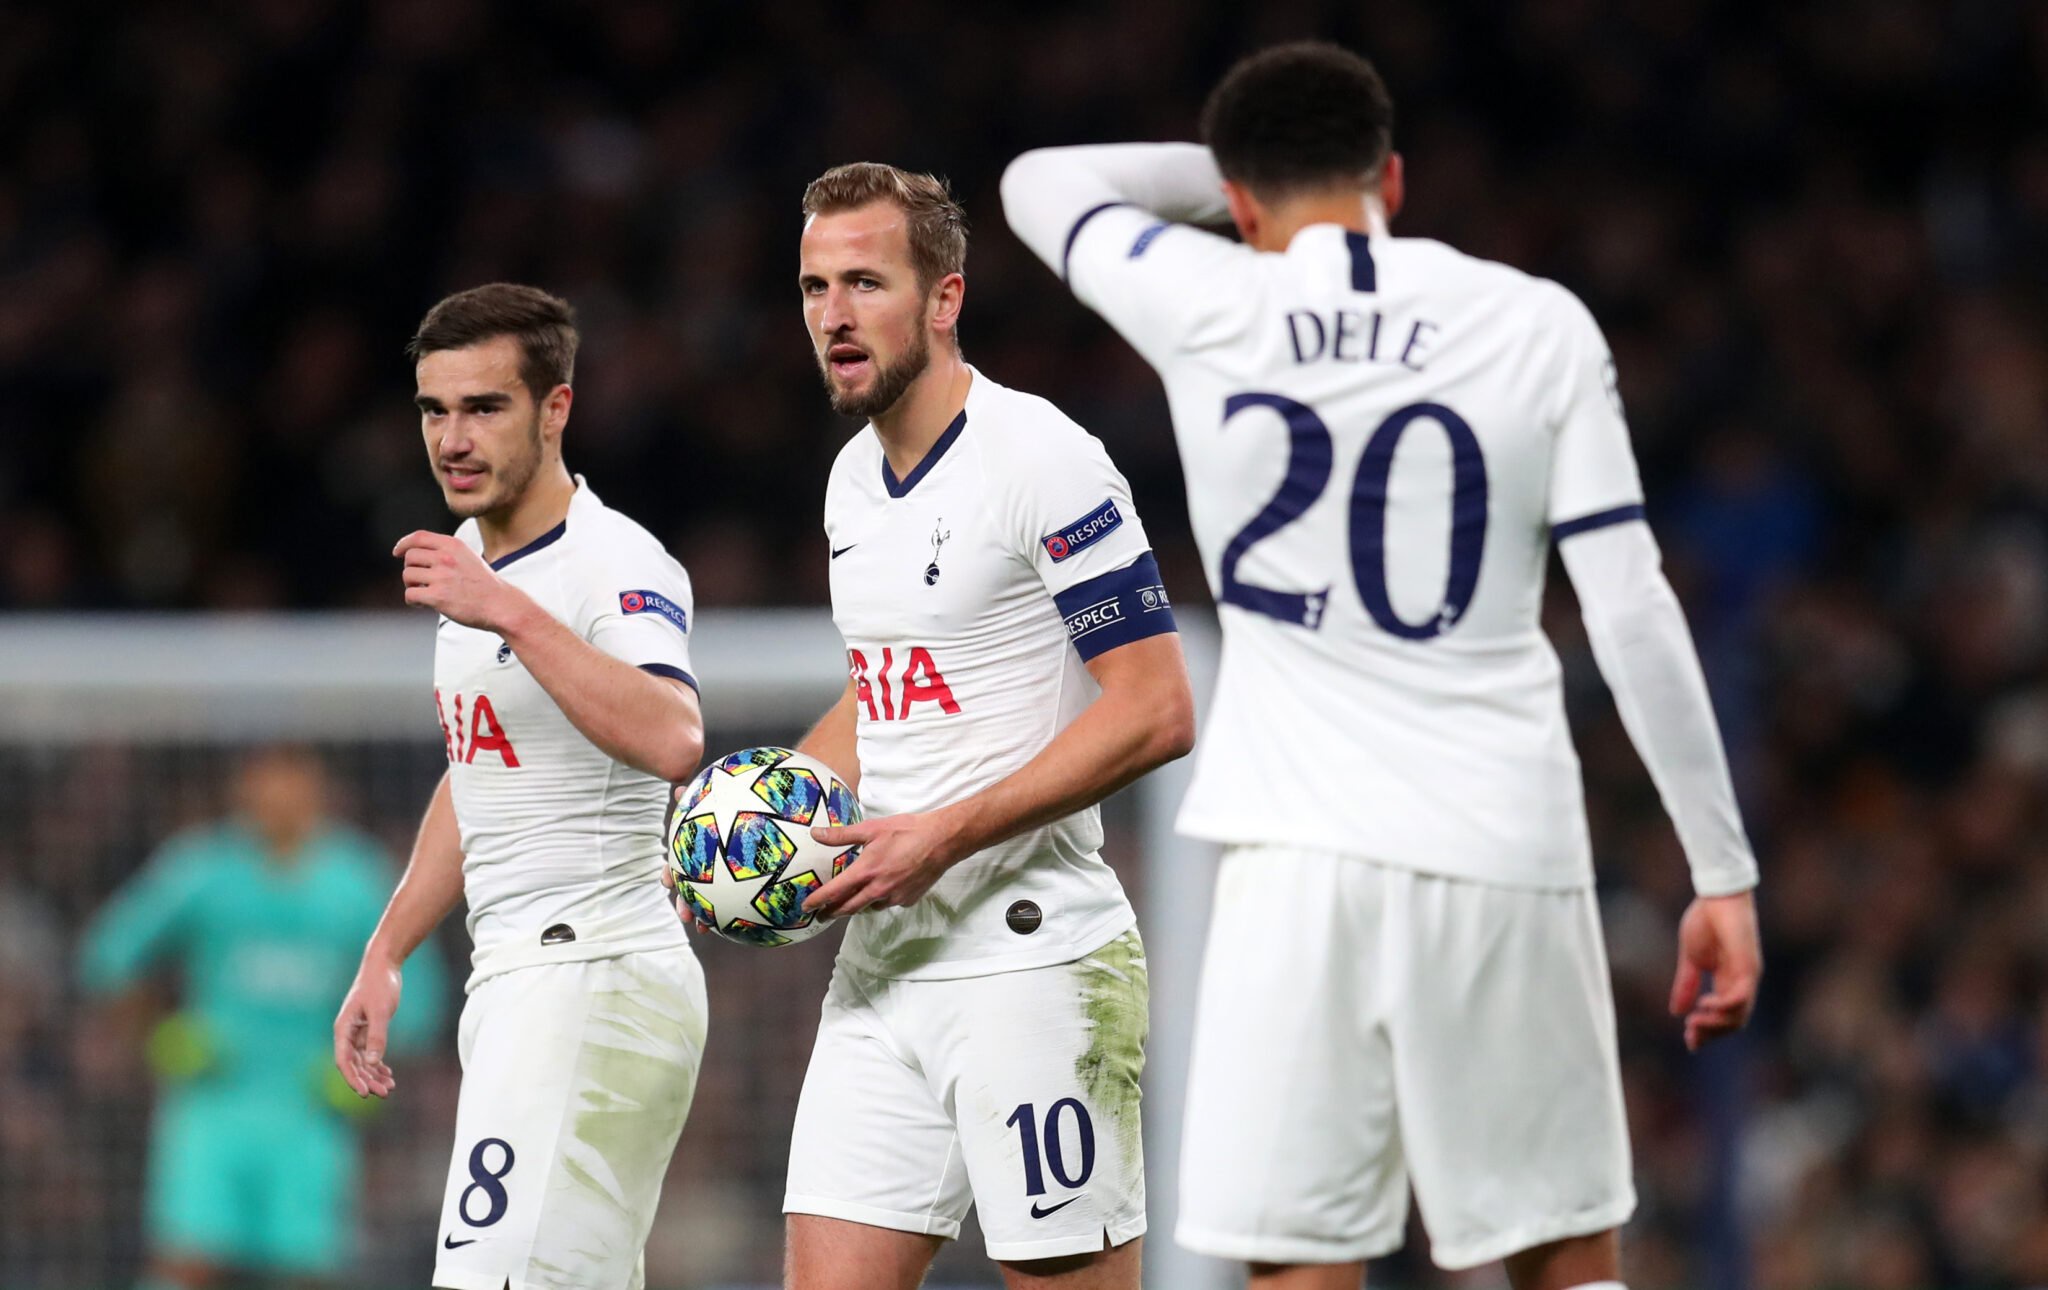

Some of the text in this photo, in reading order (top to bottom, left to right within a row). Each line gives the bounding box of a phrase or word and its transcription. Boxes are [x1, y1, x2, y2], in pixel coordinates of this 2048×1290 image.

[1287, 311, 1438, 371] DELE
[1066, 506, 1119, 547] RESPECT
[1218, 391, 1489, 640] 20
[645, 596, 685, 627] RESPECT
[459, 1137, 515, 1228] 8
[1006, 1097, 1096, 1197] 10
